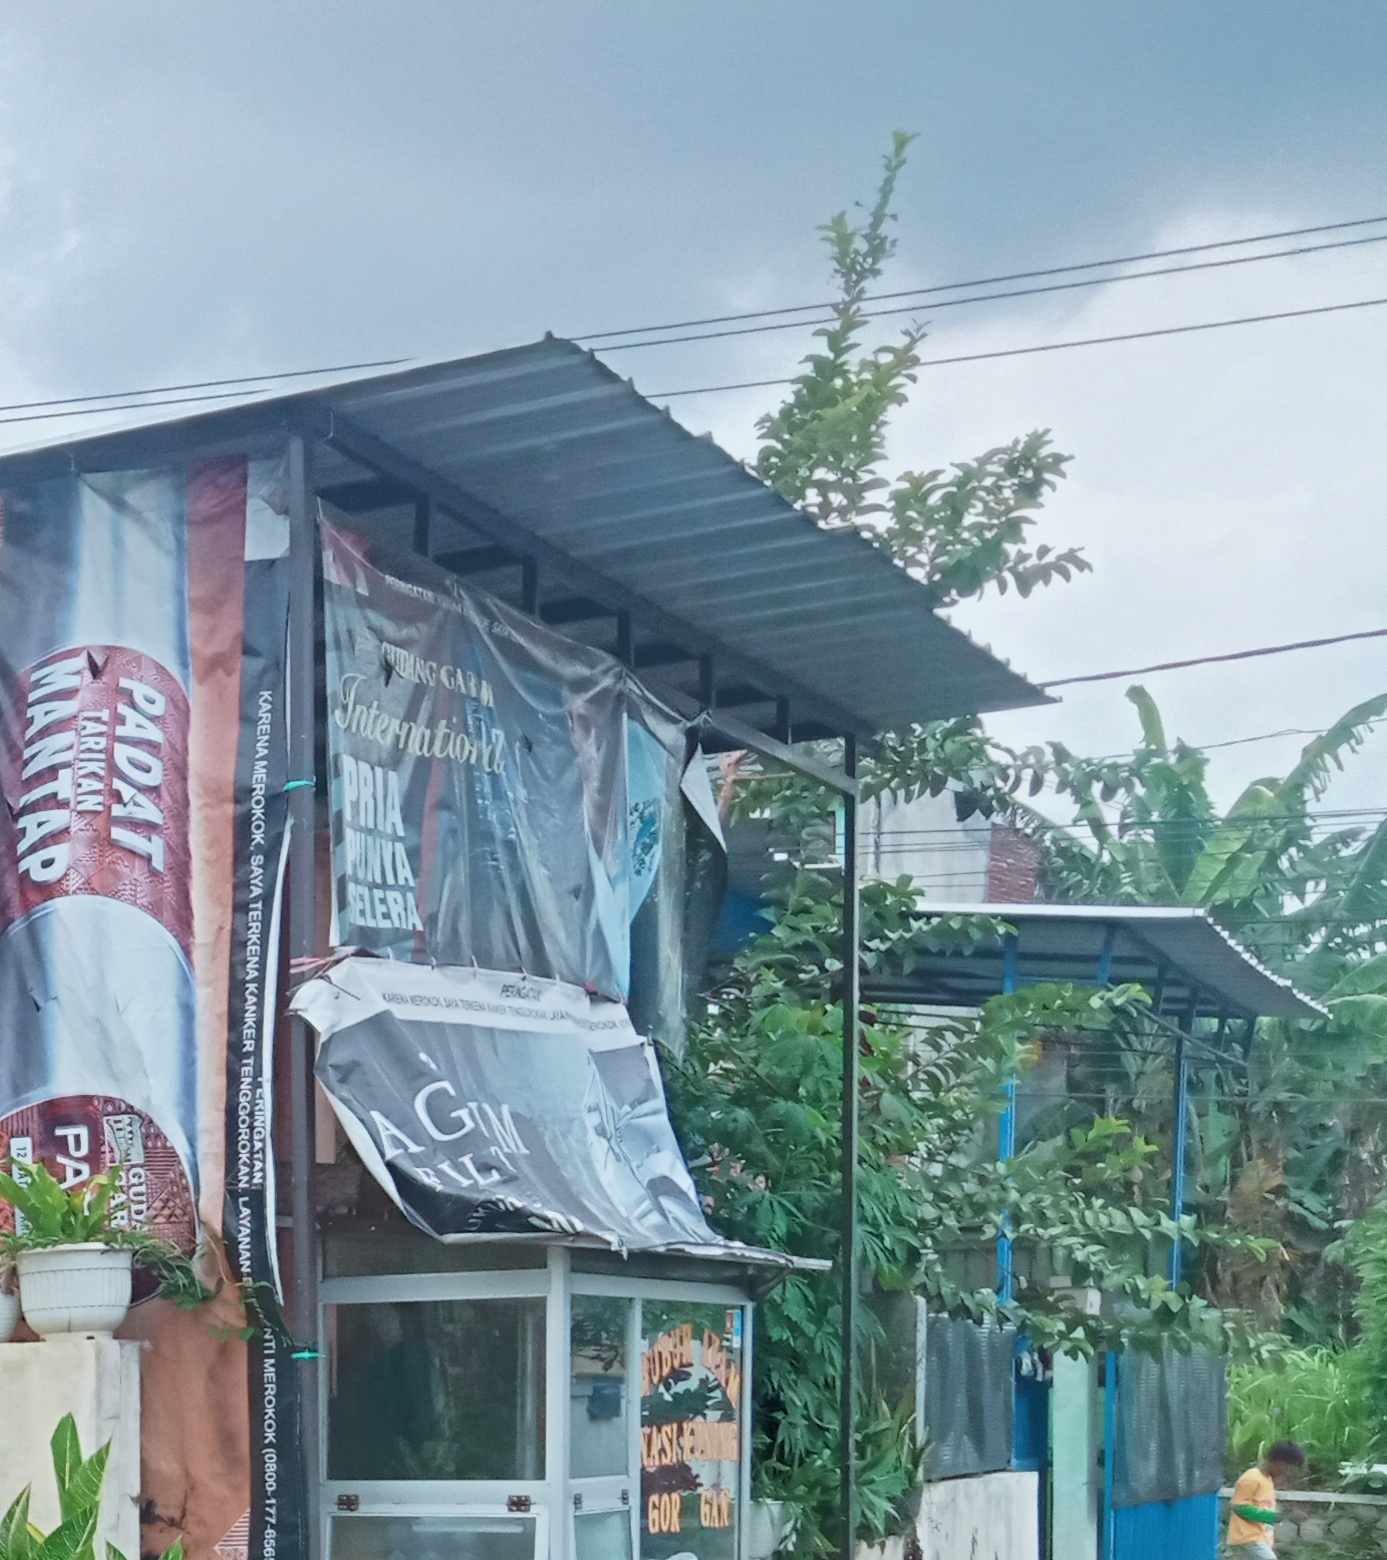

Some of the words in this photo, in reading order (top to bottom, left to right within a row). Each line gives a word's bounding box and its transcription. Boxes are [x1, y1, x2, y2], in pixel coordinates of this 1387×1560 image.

[440, 665, 494, 707] GARM
[254, 690, 273, 758] KARENA
[17, 656, 85, 882] MANTAP
[77, 709, 109, 812] TARIKAN
[111, 677, 166, 874] PADAT
[343, 754, 405, 836] PRIA
[249, 761, 269, 850] MEROKOK,
[248, 854, 264, 898] SAYA
[345, 827, 415, 887] PUNYA
[244, 900, 263, 980] TERKENA
[348, 881, 424, 931] SELERA
[242, 983, 259, 1052] KANKER
[237, 1057, 254, 1192] TENGGOROKAN.
[129, 1167, 148, 1231] GUDA
[237, 1197, 253, 1272] LAYANAN
[263, 1359, 277, 1444] MEROKOK
[641, 1422, 677, 1467] NASI
[648, 1491, 682, 1535] GOR
